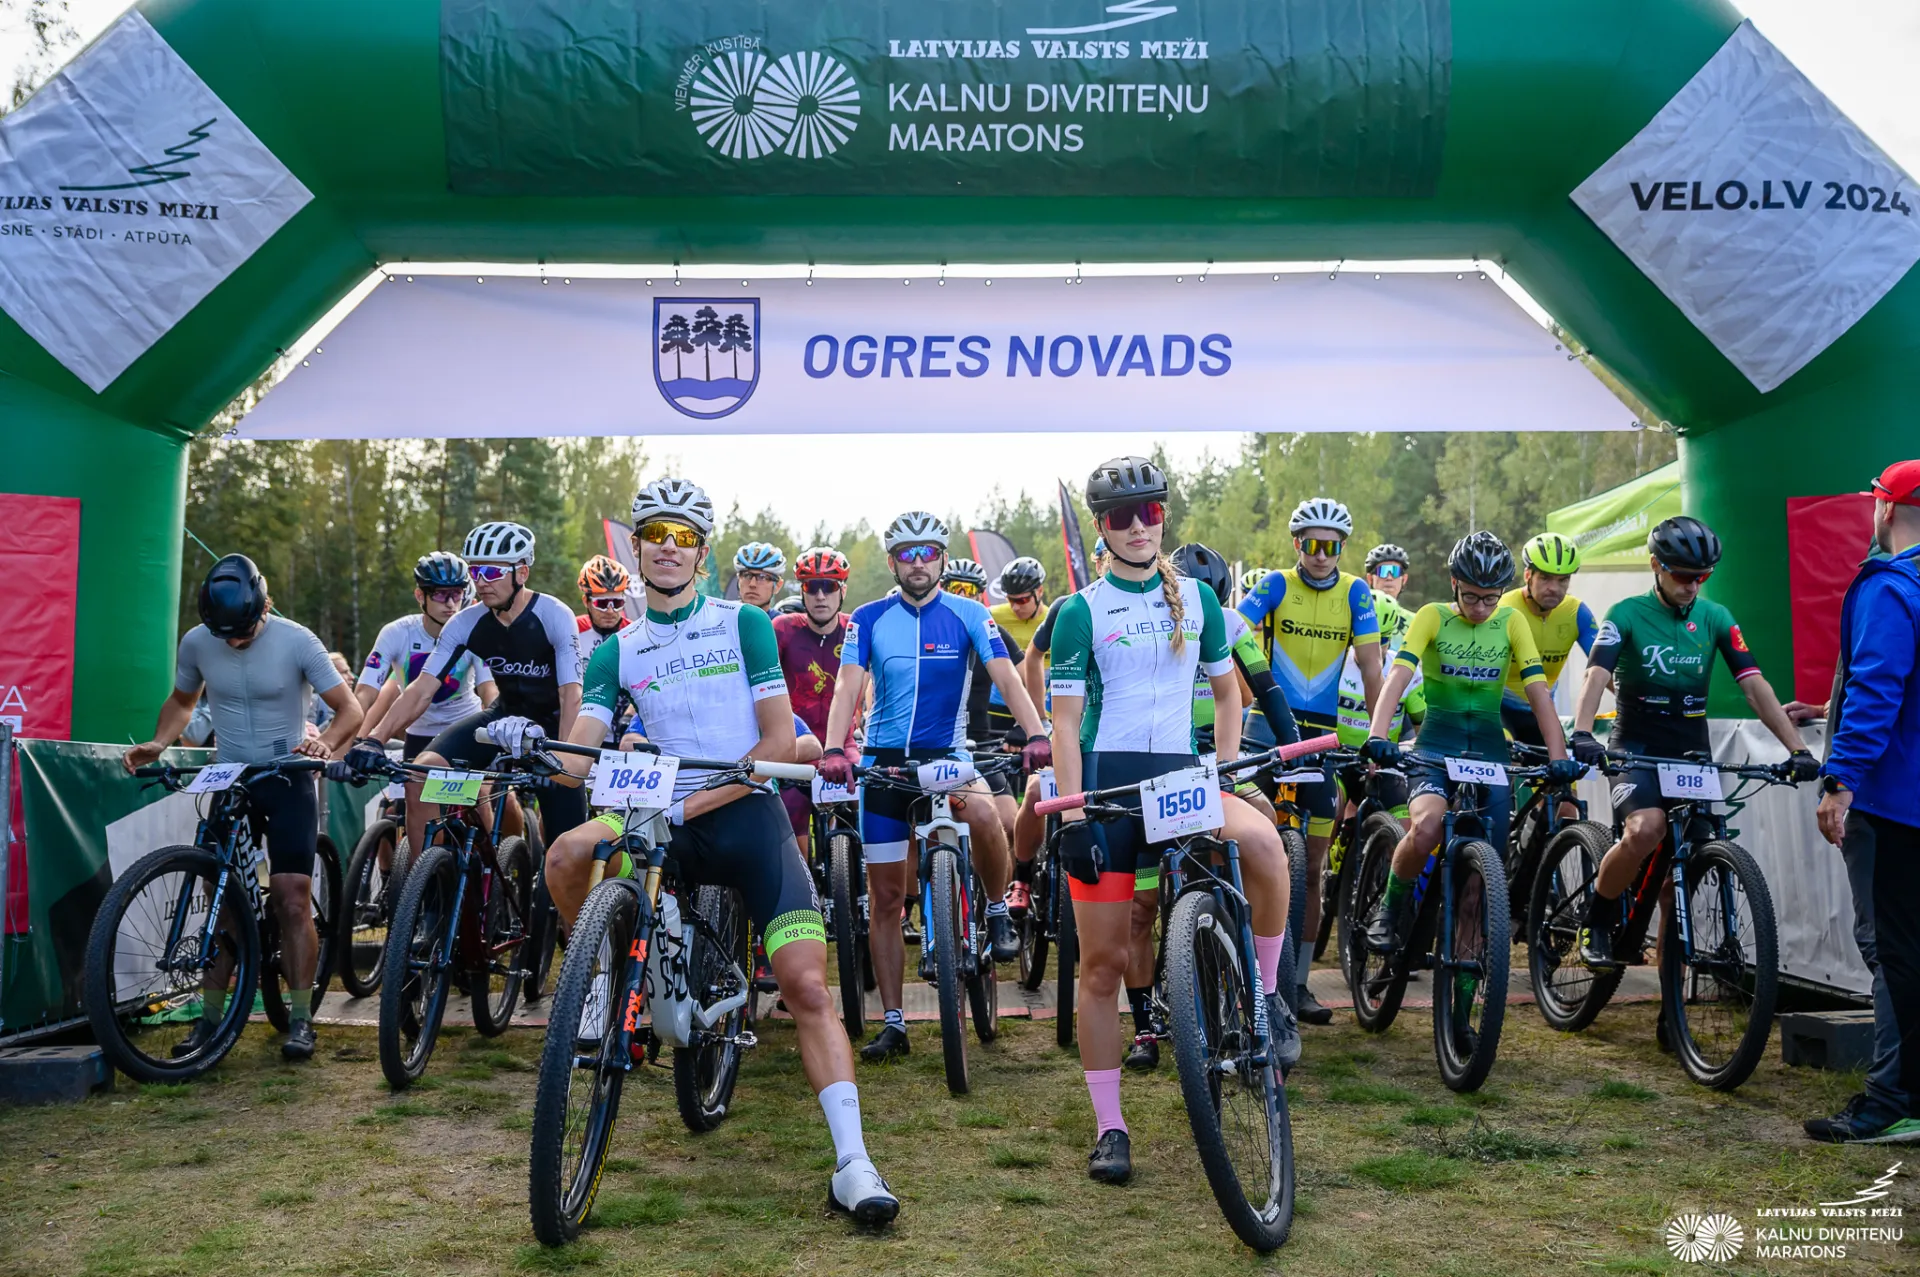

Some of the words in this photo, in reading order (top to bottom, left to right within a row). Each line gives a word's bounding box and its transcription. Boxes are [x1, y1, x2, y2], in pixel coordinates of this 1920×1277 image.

[889, 39, 1020, 59] LATVIJAS
[1032, 41, 1129, 59] VALSTS
[1141, 37, 1209, 59] MEŽI
[675, 54, 704, 111] VIENMĒR
[705, 35, 761, 56] KUSTĪBĀ
[889, 84, 1011, 112] KALNU
[1027, 84, 1209, 122] DIVRITEŅU
[889, 124, 1084, 152] MARATONS
[62, 197, 149, 216] VALSTS
[159, 202, 220, 220] MEŽI
[1630, 180, 1812, 211] VELO.LV
[1823, 182, 1911, 216] 2024
[53, 225, 103, 240] STĀDI
[124, 230, 193, 245] ATPŪTA
[803, 334, 991, 379] OGRES
[1006, 333, 1233, 378] NOVADS
[485, 656, 551, 678] Roadex
[1439, 664, 1501, 680] DAKO
[202, 770, 234, 783] 1294
[608, 769, 662, 789] 1848
[933, 763, 959, 781] 714
[1457, 765, 1495, 777] 1430
[1676, 774, 1703, 788] 818
[440, 781, 464, 793] 701
[1156, 787, 1206, 819] 1550
